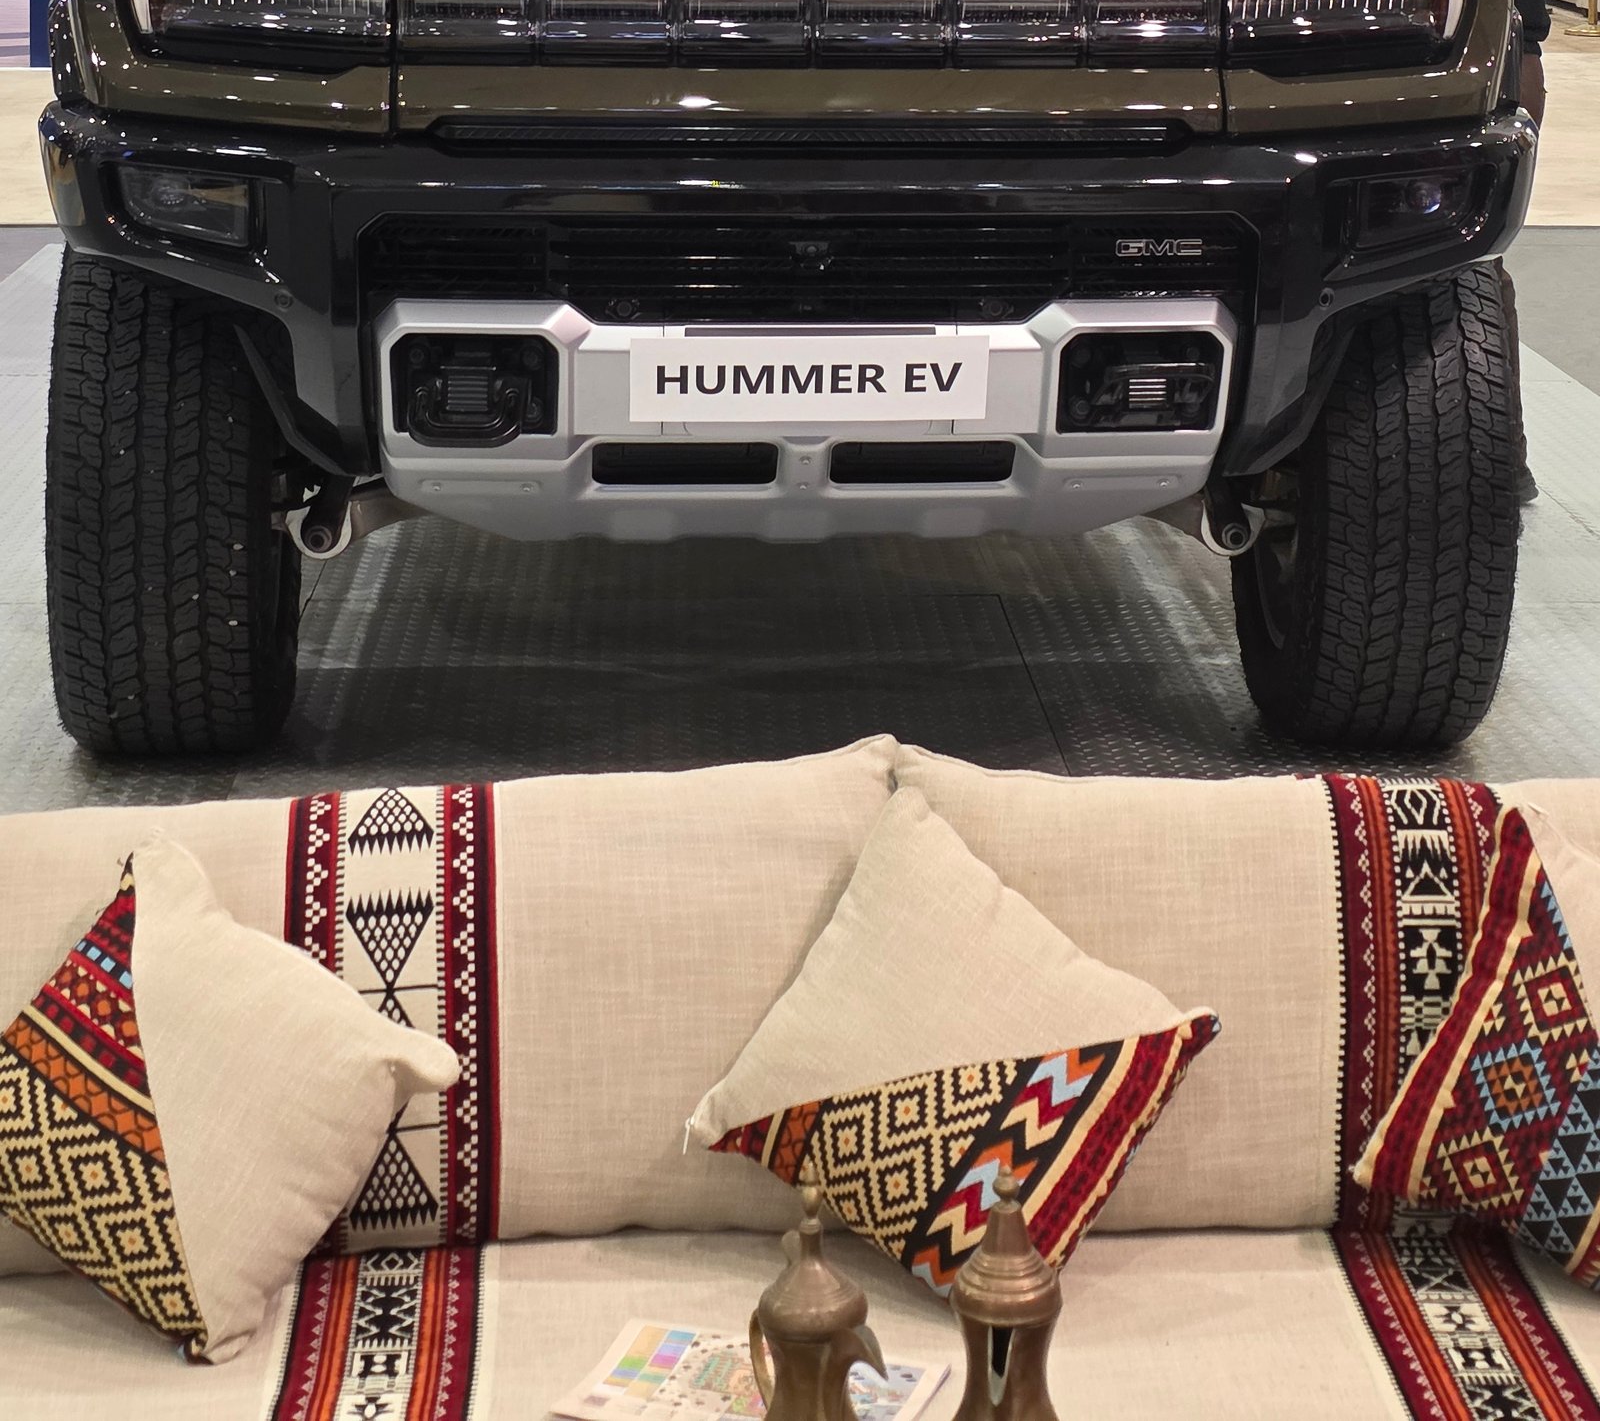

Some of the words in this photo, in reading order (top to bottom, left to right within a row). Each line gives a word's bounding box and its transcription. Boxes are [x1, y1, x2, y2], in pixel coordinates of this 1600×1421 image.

[1115, 238, 1203, 257] GMC
[656, 363, 887, 395] HUMMER
[904, 362, 963, 393] EV
